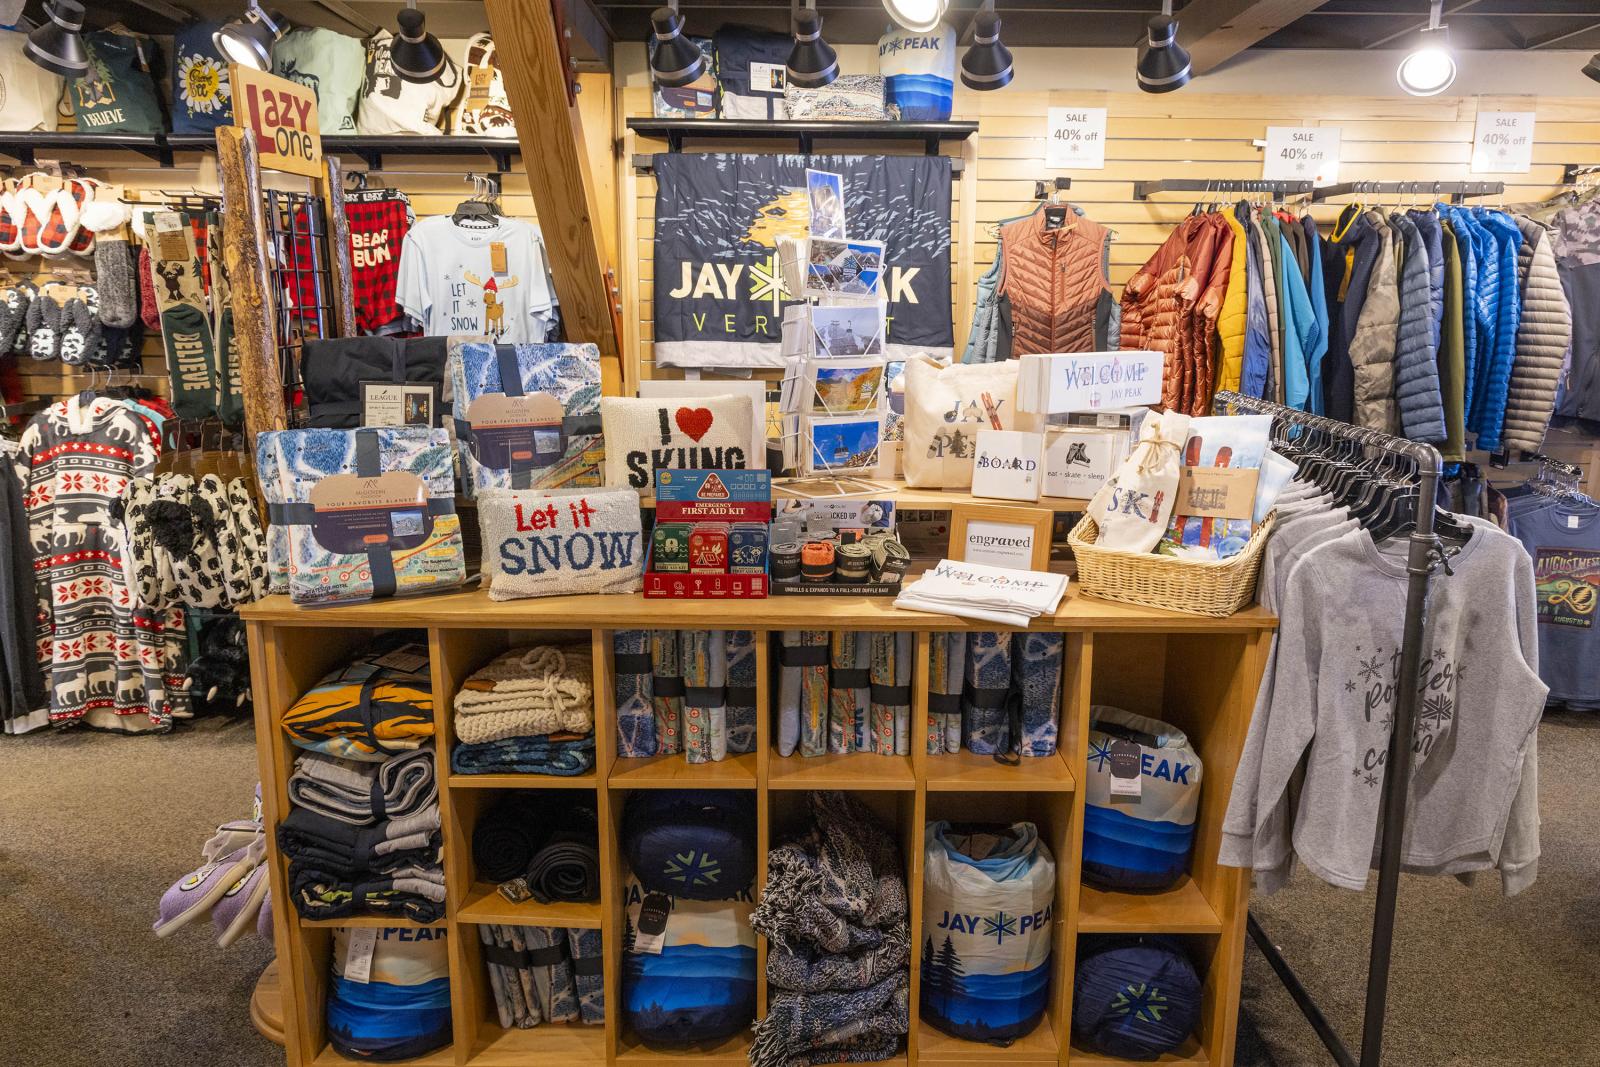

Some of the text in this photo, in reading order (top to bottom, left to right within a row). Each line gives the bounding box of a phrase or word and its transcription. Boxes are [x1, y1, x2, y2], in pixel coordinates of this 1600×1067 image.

[904, 37, 940, 50] PEAK
[89, 108, 126, 126] BELIEVE
[1066, 114, 1088, 122] SALE
[1496, 119, 1517, 127] SALE
[1054, 129, 1098, 141] 40% off
[1293, 133, 1314, 141] SALE
[1482, 133, 1527, 144] 40% off
[1280, 148, 1323, 160] 40% off
[351, 229, 389, 248] BEAR
[670, 261, 744, 300] JAY
[451, 283, 466, 297] LET
[453, 300, 460, 314] IT
[451, 317, 478, 331] SNOW
[693, 313, 895, 335] VERT
[173, 332, 211, 391] BELIEVE
[1065, 360, 1146, 391] WELCOME
[1111, 388, 1142, 400] JAY PEAK
[658, 408, 671, 446] I
[980, 456, 1037, 471] BOARD
[1087, 472, 1105, 480] sleep
[513, 498, 597, 532] Let it
[682, 507, 708, 515] FIRST
[729, 507, 746, 515] KIT
[969, 534, 1031, 548] engraved
[499, 531, 639, 575] SNOW
[1142, 753, 1193, 785] EAK
[937, 904, 1054, 935] JAY PEA
